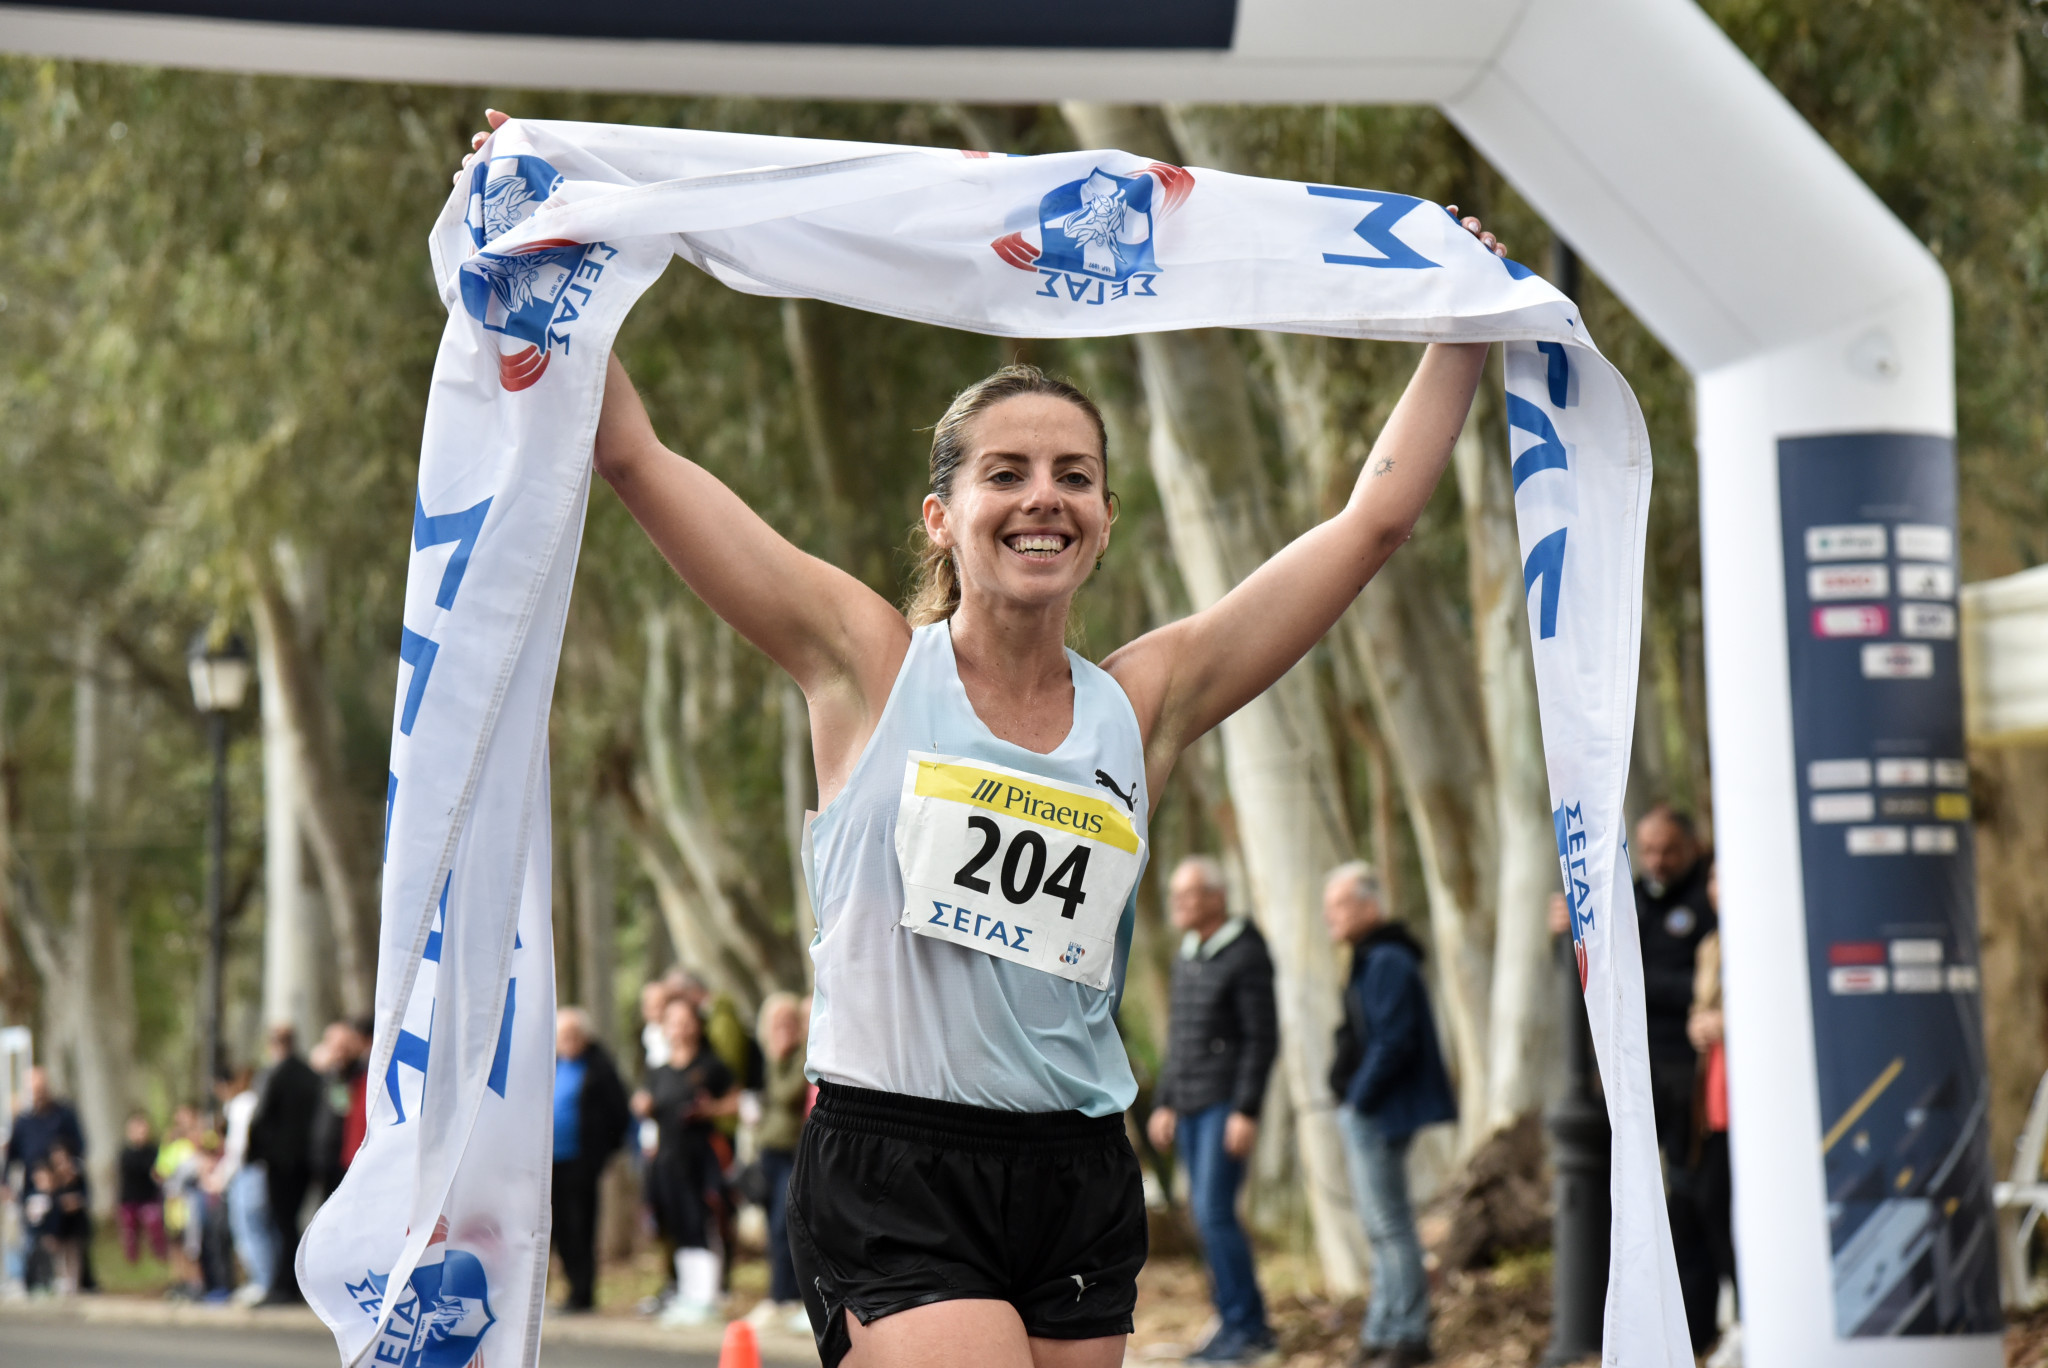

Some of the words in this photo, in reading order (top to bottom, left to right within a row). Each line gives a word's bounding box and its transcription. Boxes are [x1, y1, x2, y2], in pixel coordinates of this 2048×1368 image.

[546, 241, 619, 356] ΣΕΓΑΣ
[1035, 269, 1158, 305] ΣΕΓΑΣ
[1004, 784, 1104, 834] Piraeus
[953, 815, 1092, 920] 204
[1565, 800, 1596, 937] ΣΕΓΑΣ
[928, 900, 1033, 953] ΣΕΓΑΣ
